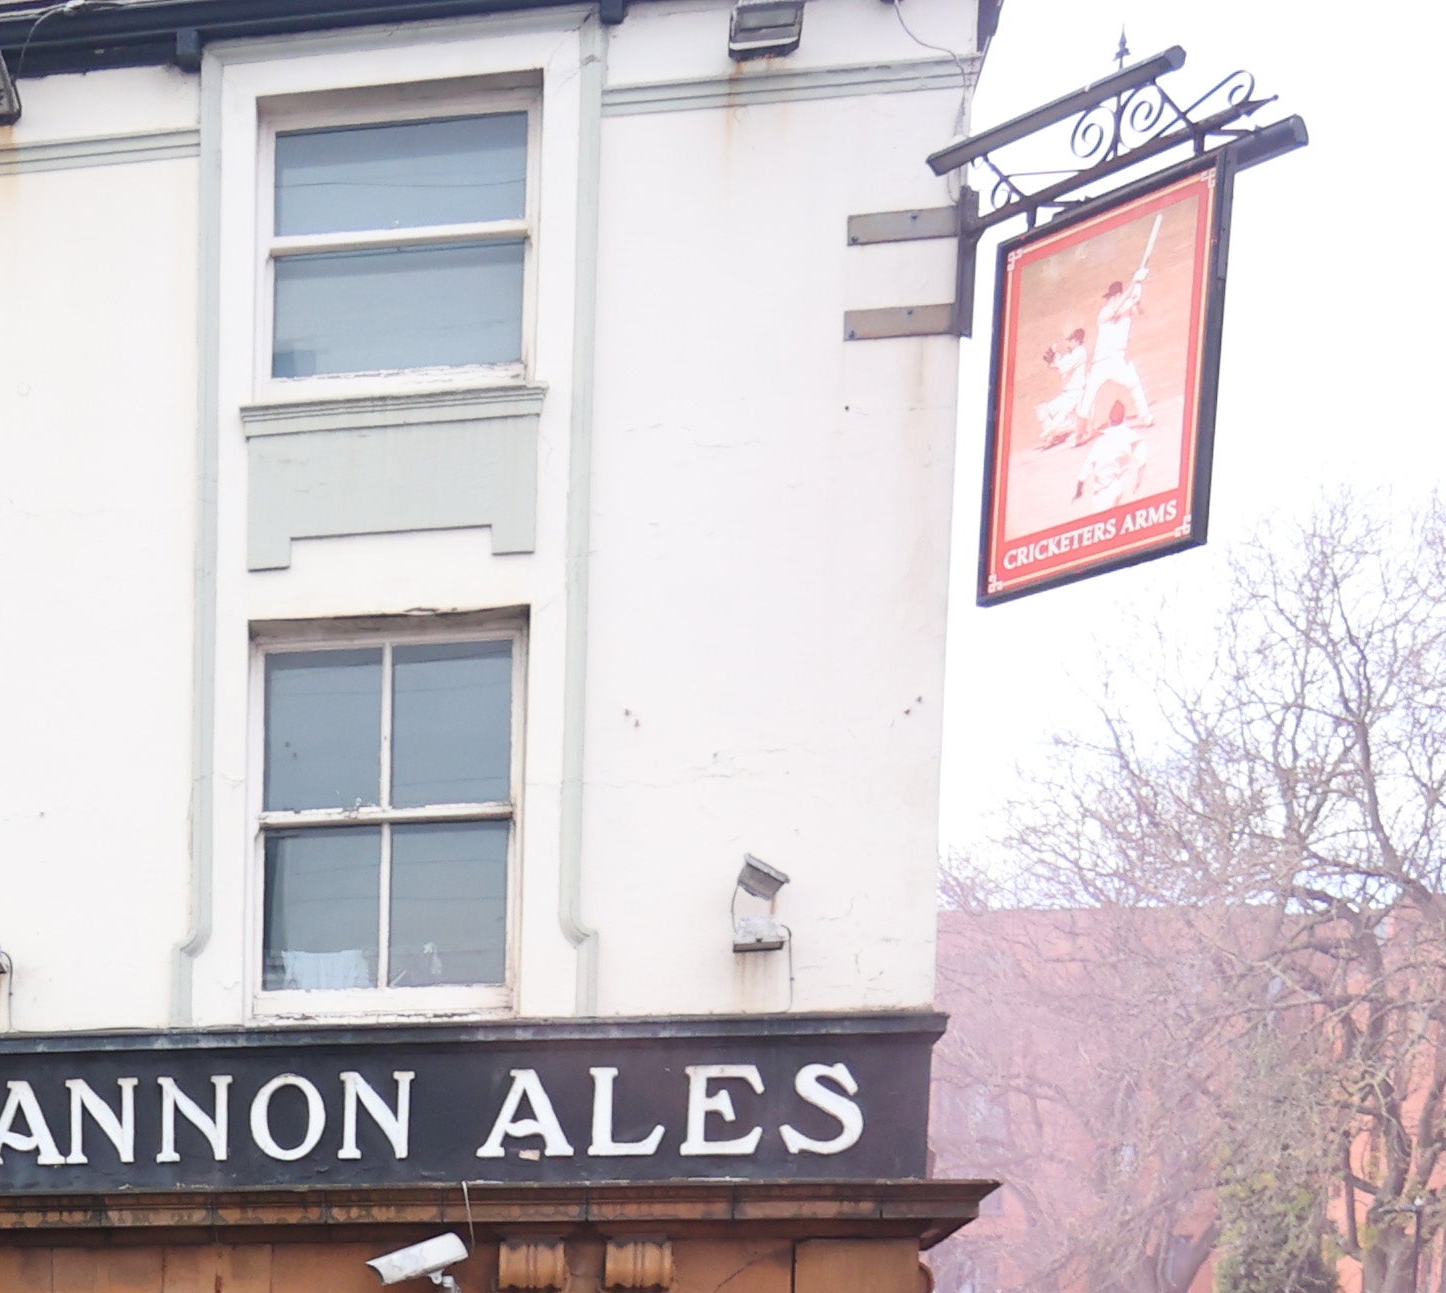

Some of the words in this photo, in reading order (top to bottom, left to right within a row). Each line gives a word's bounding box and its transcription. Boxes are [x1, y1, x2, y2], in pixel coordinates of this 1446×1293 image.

[1002, 519, 1117, 571] CRICKETERS
[1118, 499, 1178, 535] ARMS
[476, 1062, 865, 1157] ALES
